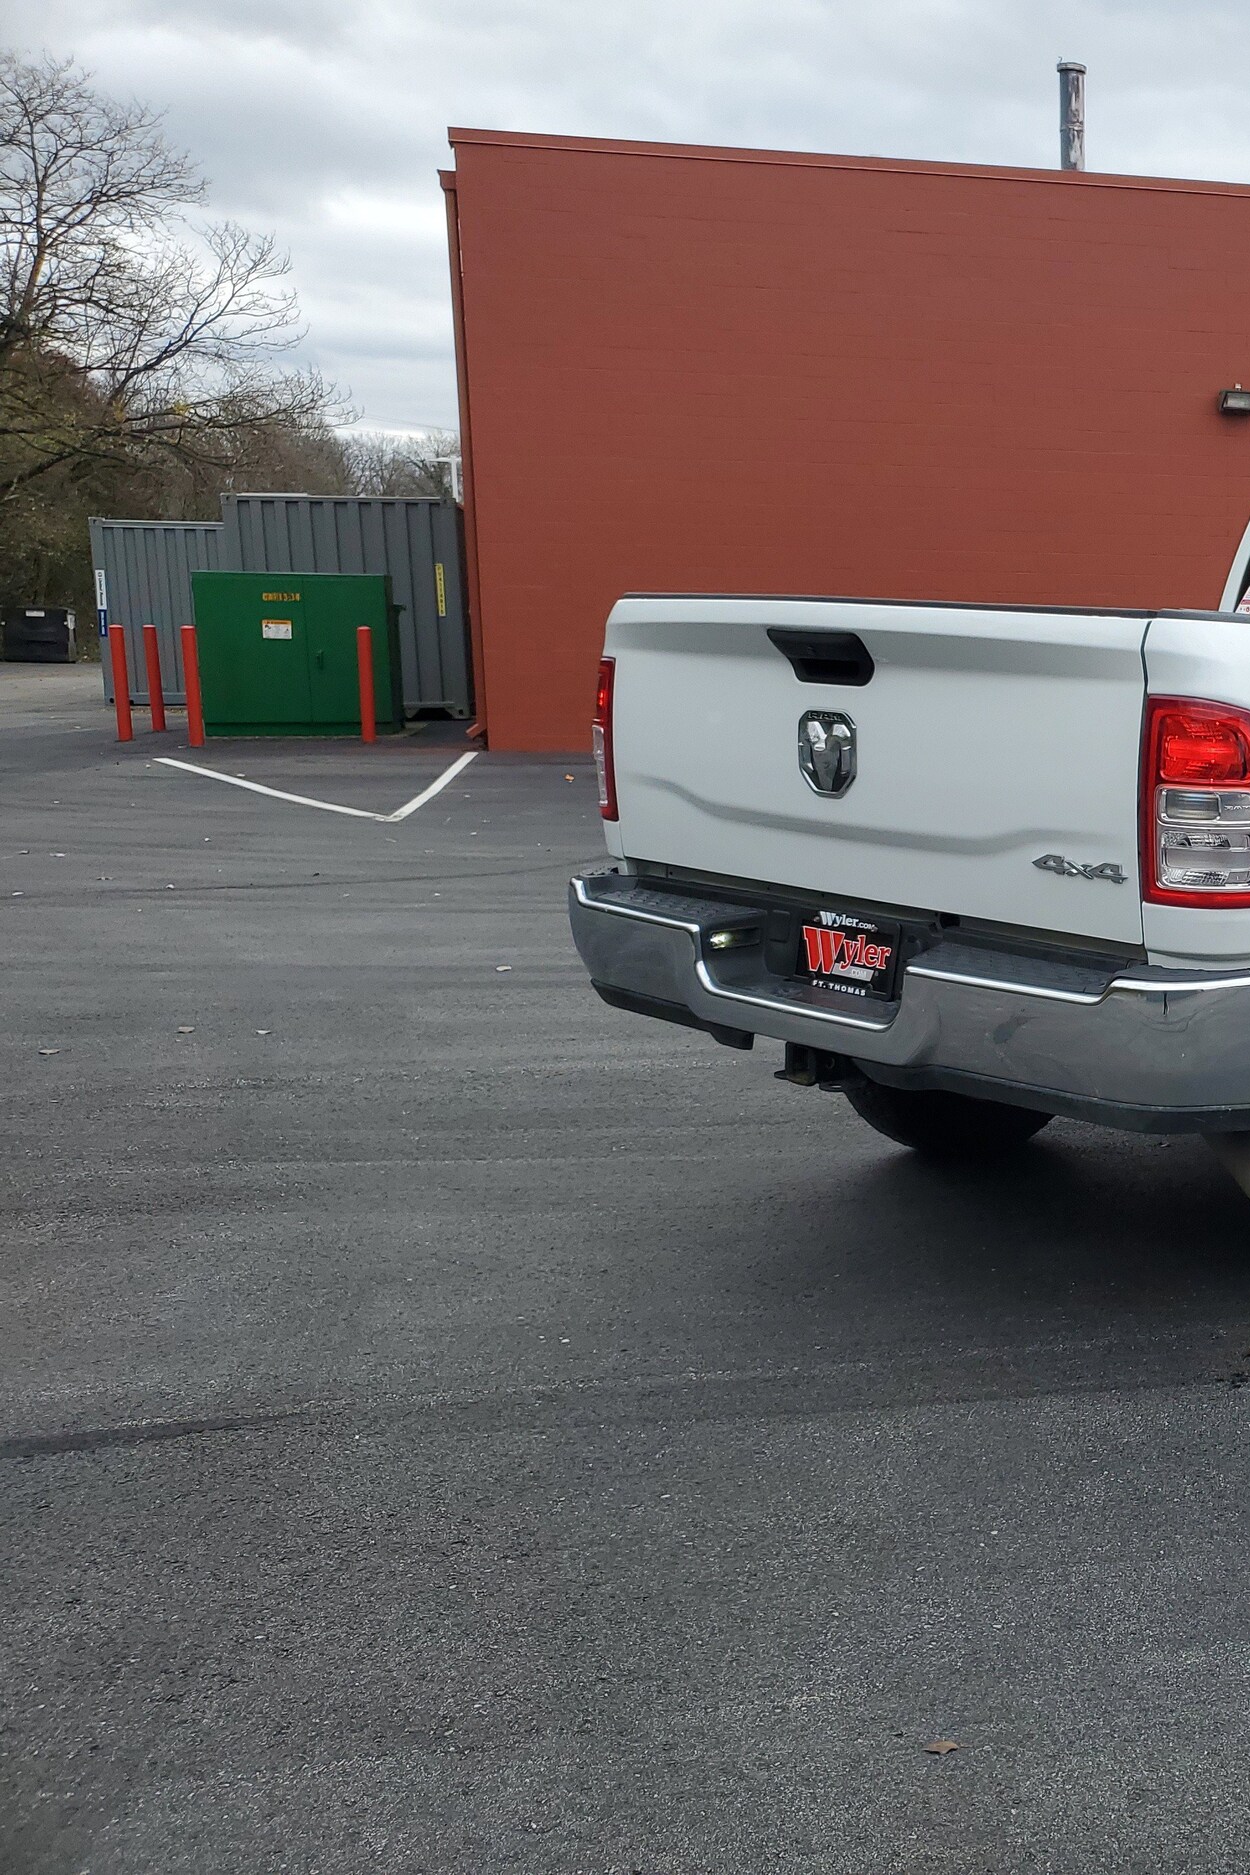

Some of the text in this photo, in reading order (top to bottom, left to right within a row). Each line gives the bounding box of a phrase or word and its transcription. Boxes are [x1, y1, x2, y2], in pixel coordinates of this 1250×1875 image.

[802, 925, 891, 975] Wyler
[812, 979, 867, 997] FT. THOMAS
